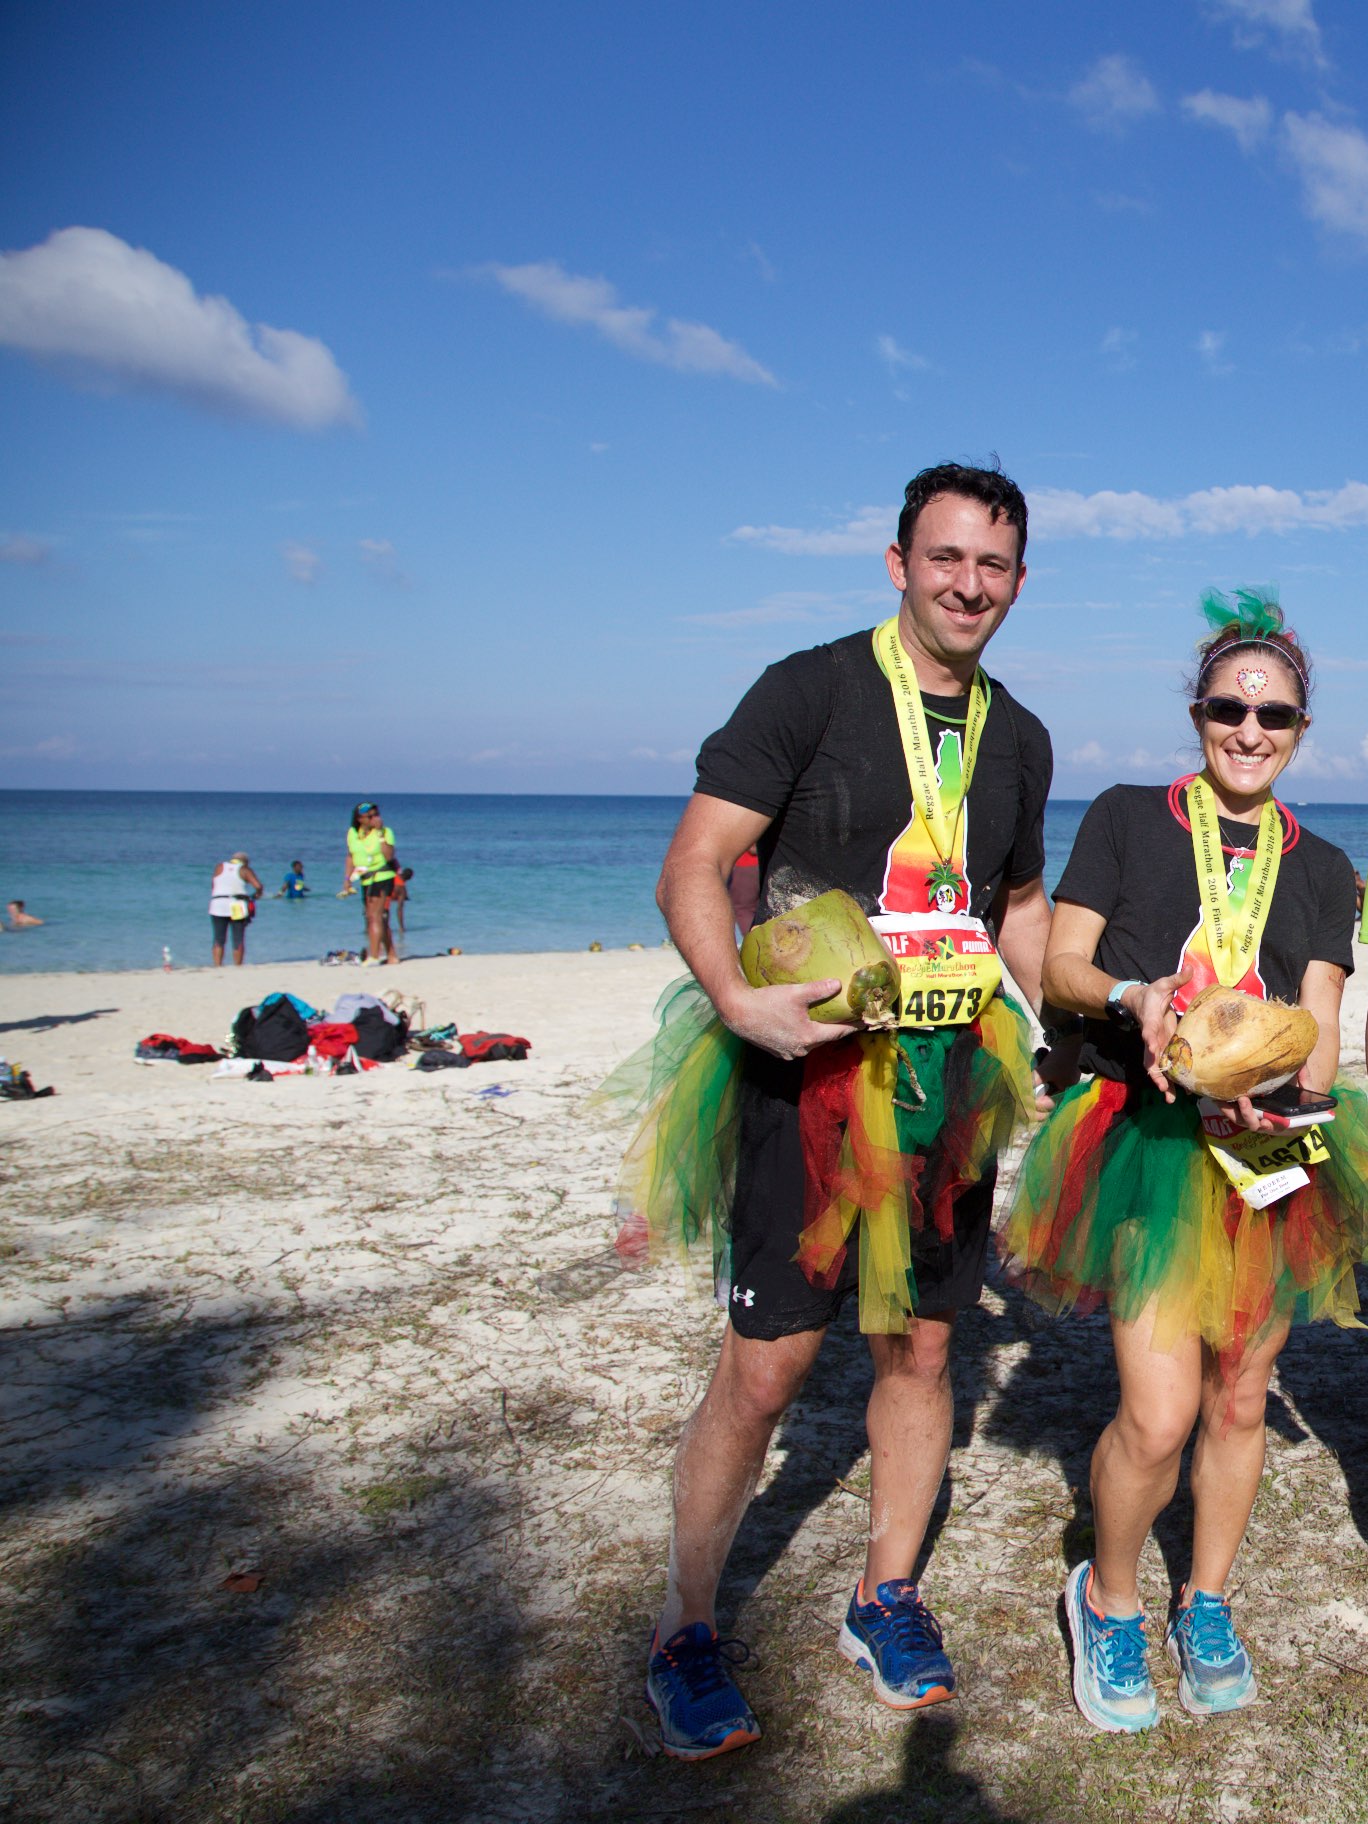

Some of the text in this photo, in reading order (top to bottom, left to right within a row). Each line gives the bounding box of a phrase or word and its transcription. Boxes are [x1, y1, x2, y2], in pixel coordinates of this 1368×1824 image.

[889, 635, 935, 820] Reggae Half Marathon 2016 Finisher
[1266, 835, 1275, 854] 2016
[1194, 785, 1224, 949] Reggae Half Marathon 2016 Finisher
[1256, 857, 1272, 897] Marathon
[1251, 899, 1262, 920] Half
[962, 941, 989, 953] PUMA
[1240, 923, 1255, 954] Reggae
